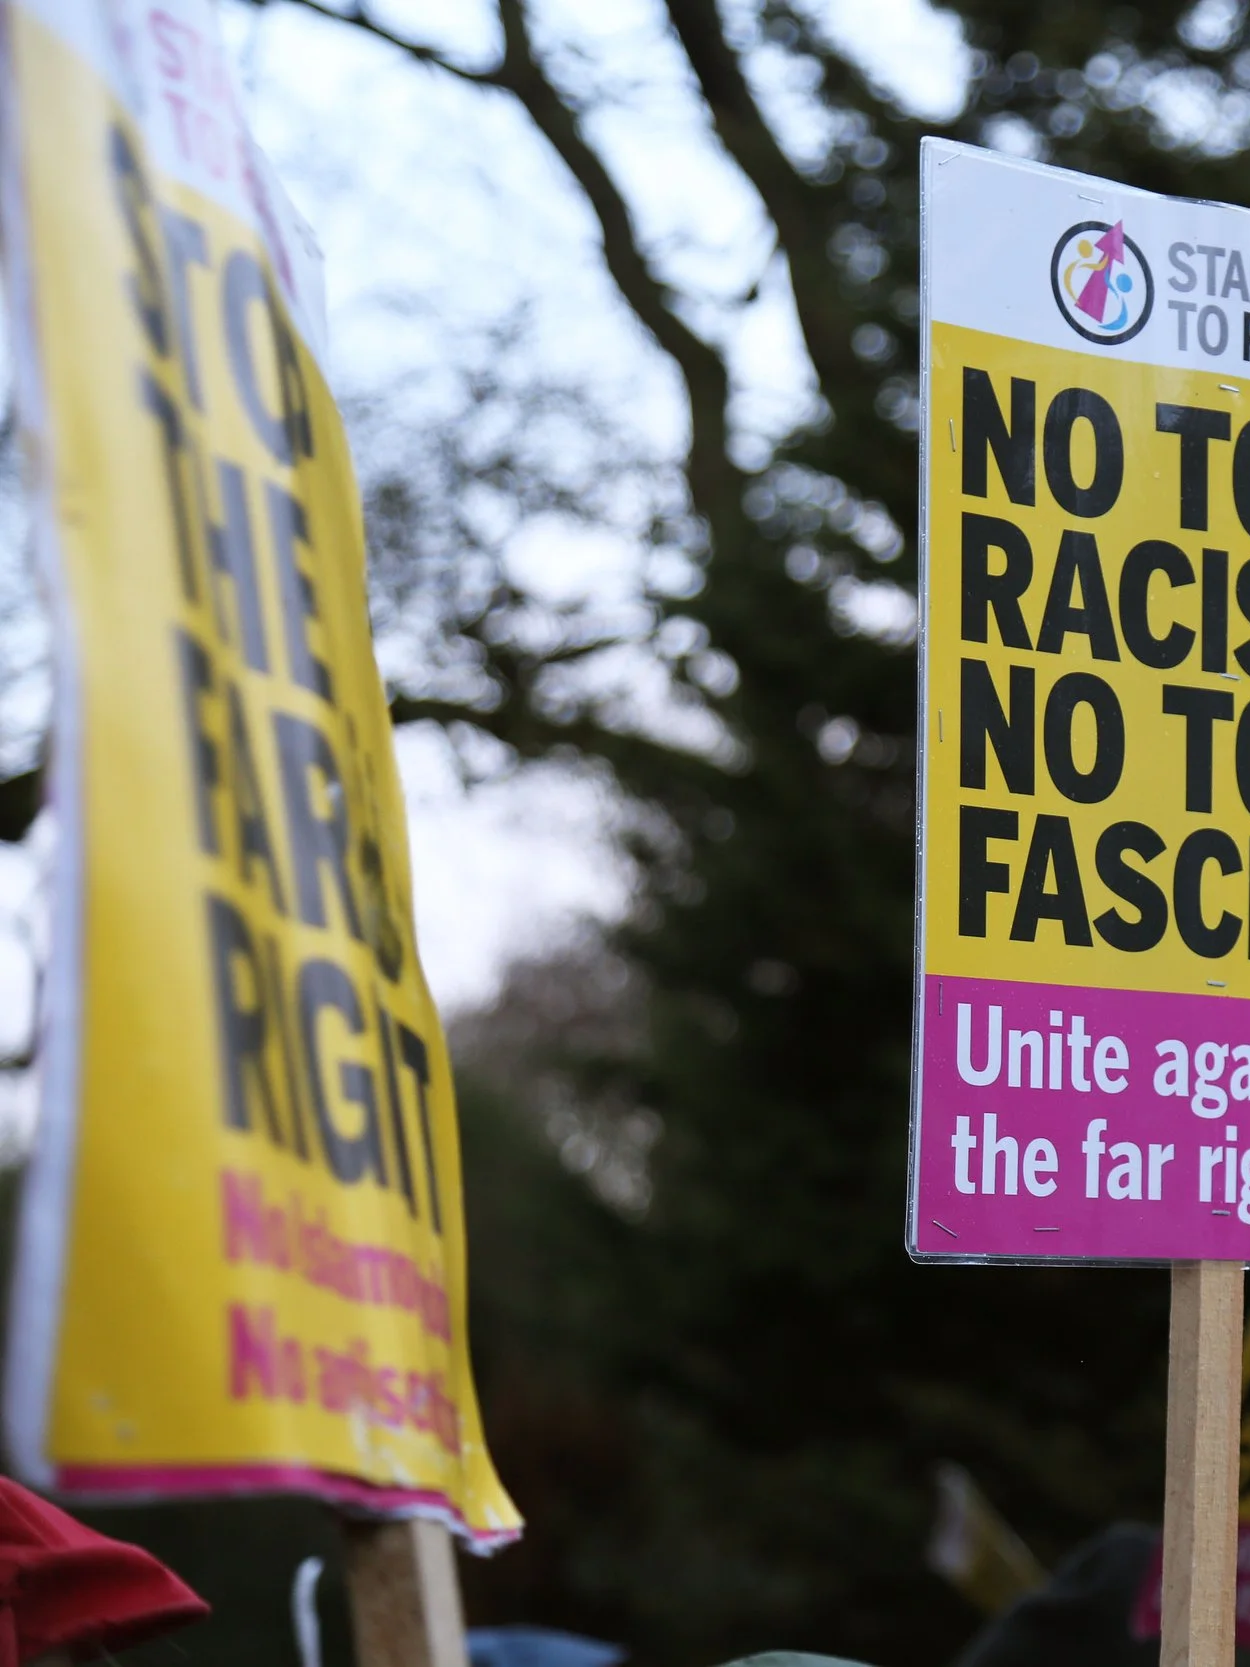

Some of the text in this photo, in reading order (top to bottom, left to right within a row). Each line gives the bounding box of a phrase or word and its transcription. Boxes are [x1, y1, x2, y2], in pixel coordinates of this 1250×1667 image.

[1168, 298, 1229, 356] TO
[961, 366, 1124, 518] NO
[136, 362, 335, 710] THE
[959, 657, 1126, 804] NO
[955, 1002, 1130, 1095] Unite
[951, 1112, 1059, 1198] the
[1082, 1117, 1175, 1202] far
